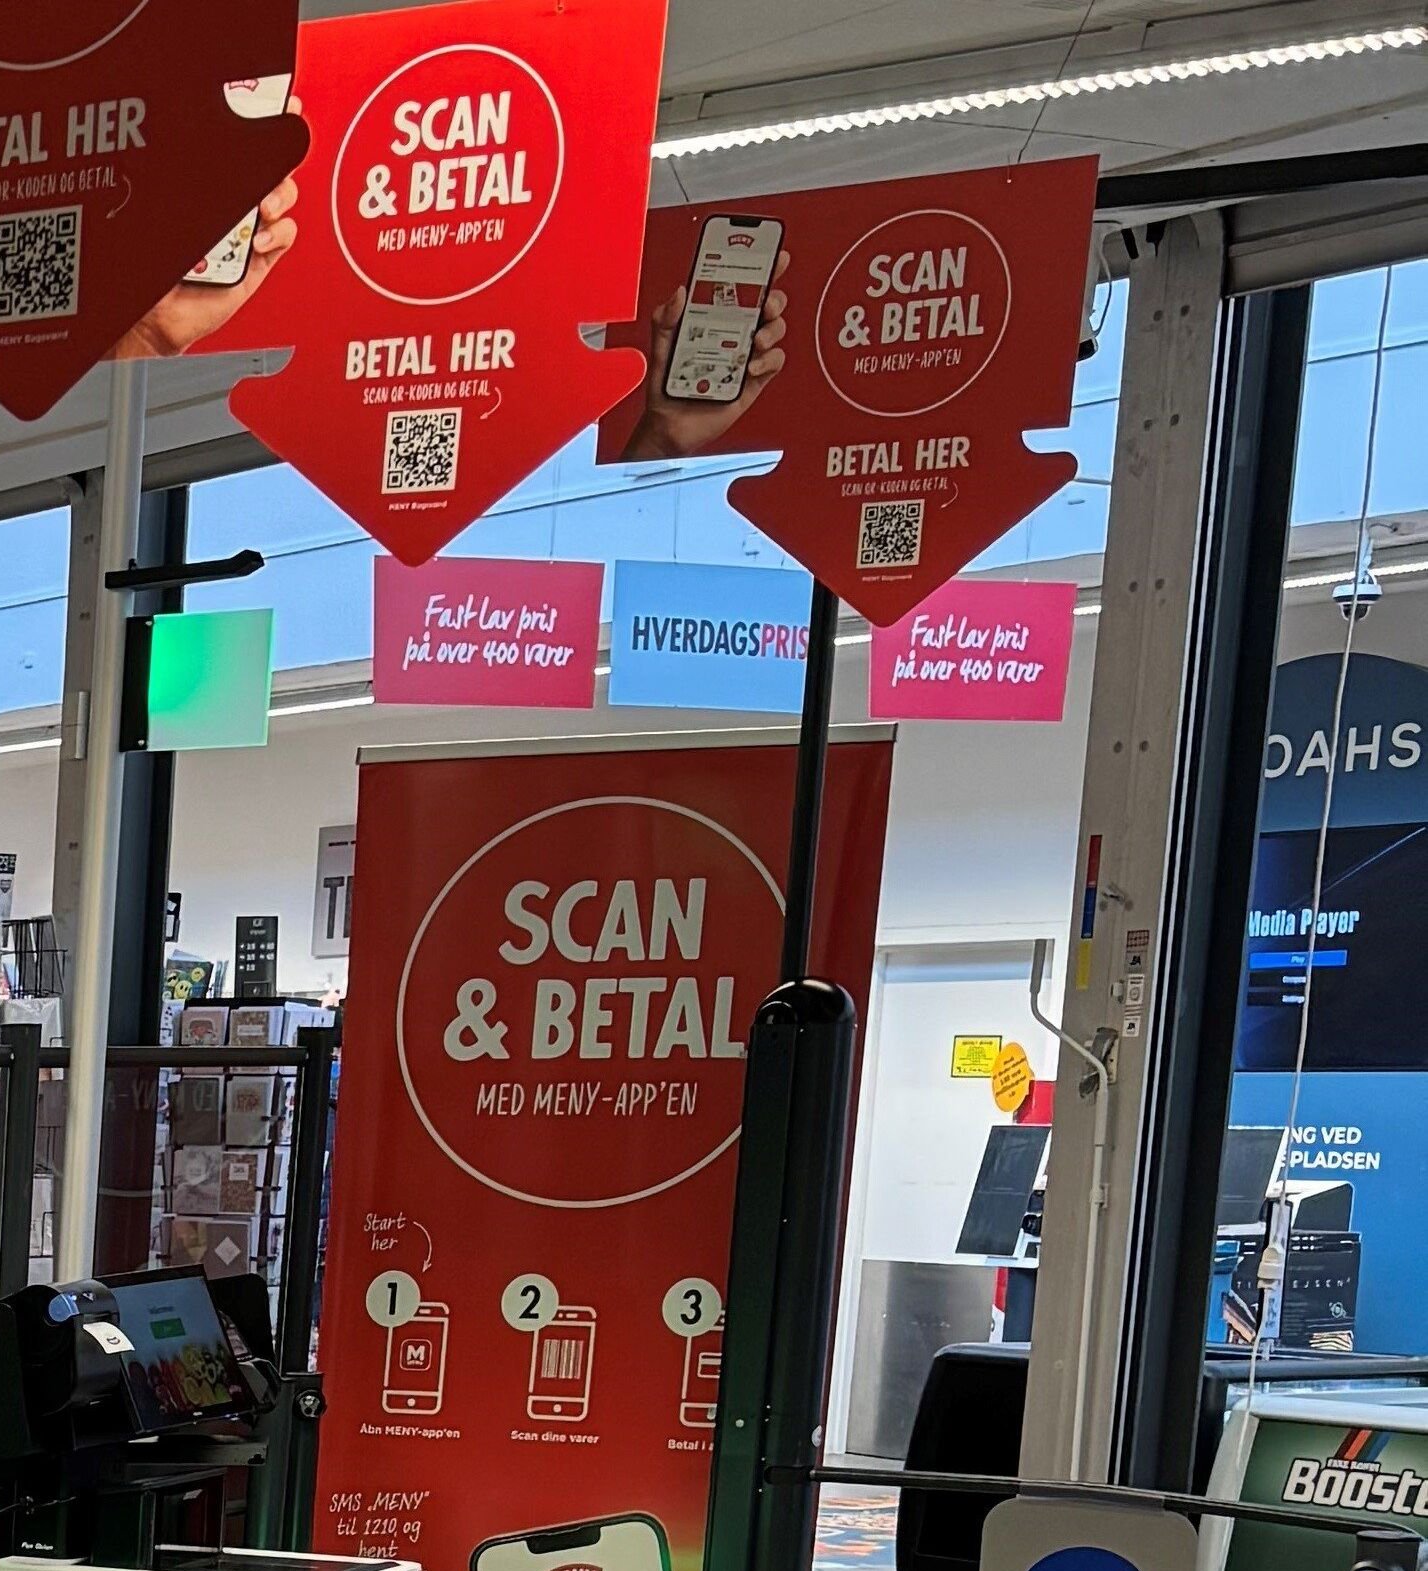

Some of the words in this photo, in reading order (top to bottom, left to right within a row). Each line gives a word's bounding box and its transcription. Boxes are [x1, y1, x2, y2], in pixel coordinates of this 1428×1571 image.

[66, 97, 147, 158] HER
[390, 90, 512, 156] SCAN
[59, 171, 75, 193] OG
[78, 165, 117, 190] BETAL
[358, 164, 398, 219] &
[408, 150, 532, 214] BETAL
[377, 228, 406, 253] MED
[409, 218, 505, 250] MENY-APP'EN
[865, 246, 967, 298] SCAN
[838, 305, 871, 348] &
[880, 294, 984, 344] BETAL
[345, 335, 436, 380] BETAL
[450, 328, 515, 373] HER
[854, 356, 878, 374] MED
[363, 386, 388, 405] SCAN
[390, 381, 443, 403] QR-KODEN
[444, 381, 457, 399] OG
[459, 379, 491, 398] BETAL
[826, 441, 903, 478] BETAL
[915, 436, 971, 471] HER
[425, 594, 477, 630] Fast
[478, 596, 515, 630] lav
[515, 604, 557, 639] pris
[402, 631, 433, 671] på
[436, 642, 479, 664] over
[482, 639, 519, 667] 400
[524, 642, 574, 668] varer
[632, 615, 809, 661] HVERDAGSPRIS
[911, 614, 956, 648] Fast
[957, 616, 990, 649] lav
[990, 623, 1029, 657] pris
[892, 650, 918, 687] på
[919, 660, 957, 681] over
[959, 658, 992, 684] 400
[996, 660, 1044, 684] varer
[498, 877, 707, 965] SCAN
[1248, 909, 1296, 937] Media
[1300, 908, 1360, 938] Payer
[444, 979, 508, 1062] &
[531, 976, 745, 1060] BETAL
[476, 1083, 524, 1117] MED
[533, 1081, 697, 1118] MENY-APP'EN
[1321, 1126, 1362, 1145] VED
[364, 1212, 407, 1232] Start
[371, 1229, 398, 1251] her
[387, 1281, 399, 1316] 1
[519, 1284, 542, 1320] 2
[680, 1289, 704, 1326] 3
[360, 1422, 382, 1436] Åbn
[385, 1424, 460, 1440] MENY-app'en
[511, 1430, 541, 1442] Scan
[544, 1431, 567, 1443] dine
[569, 1433, 600, 1445] varer
[668, 1438, 699, 1451] Betal
[329, 1492, 363, 1513] SMS
[337, 1516, 357, 1535] til
[403, 1521, 421, 1543] og
[358, 1540, 400, 1558] hent
